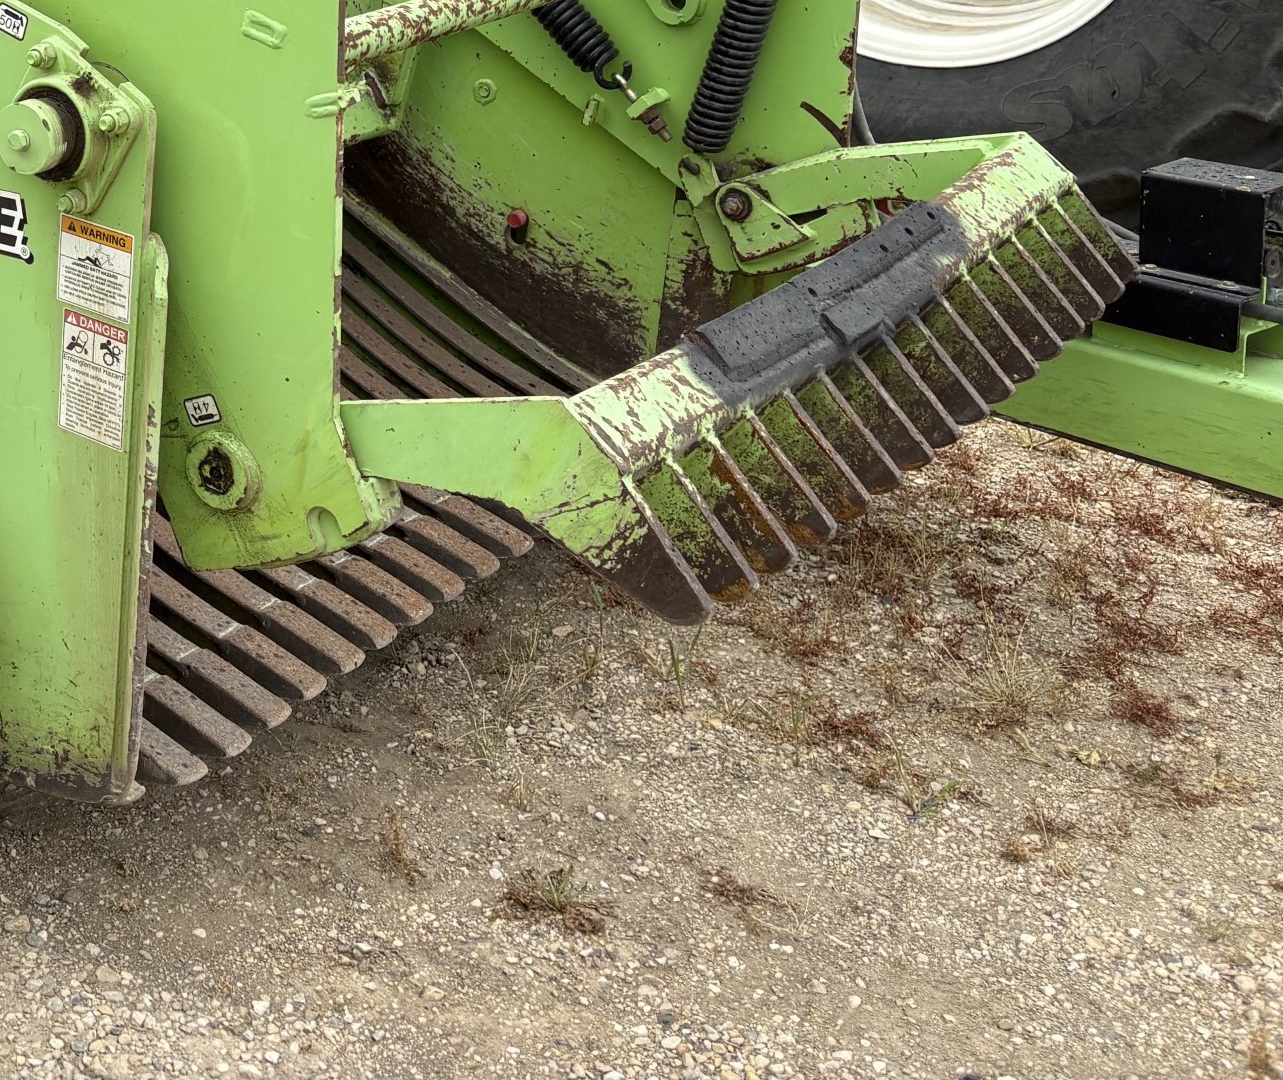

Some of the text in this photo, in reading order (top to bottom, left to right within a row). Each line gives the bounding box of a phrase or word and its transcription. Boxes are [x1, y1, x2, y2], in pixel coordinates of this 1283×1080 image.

[80, 224, 126, 248] WARNING
[79, 316, 126, 342] DANGER
[102, 366, 124, 381] Hazard
